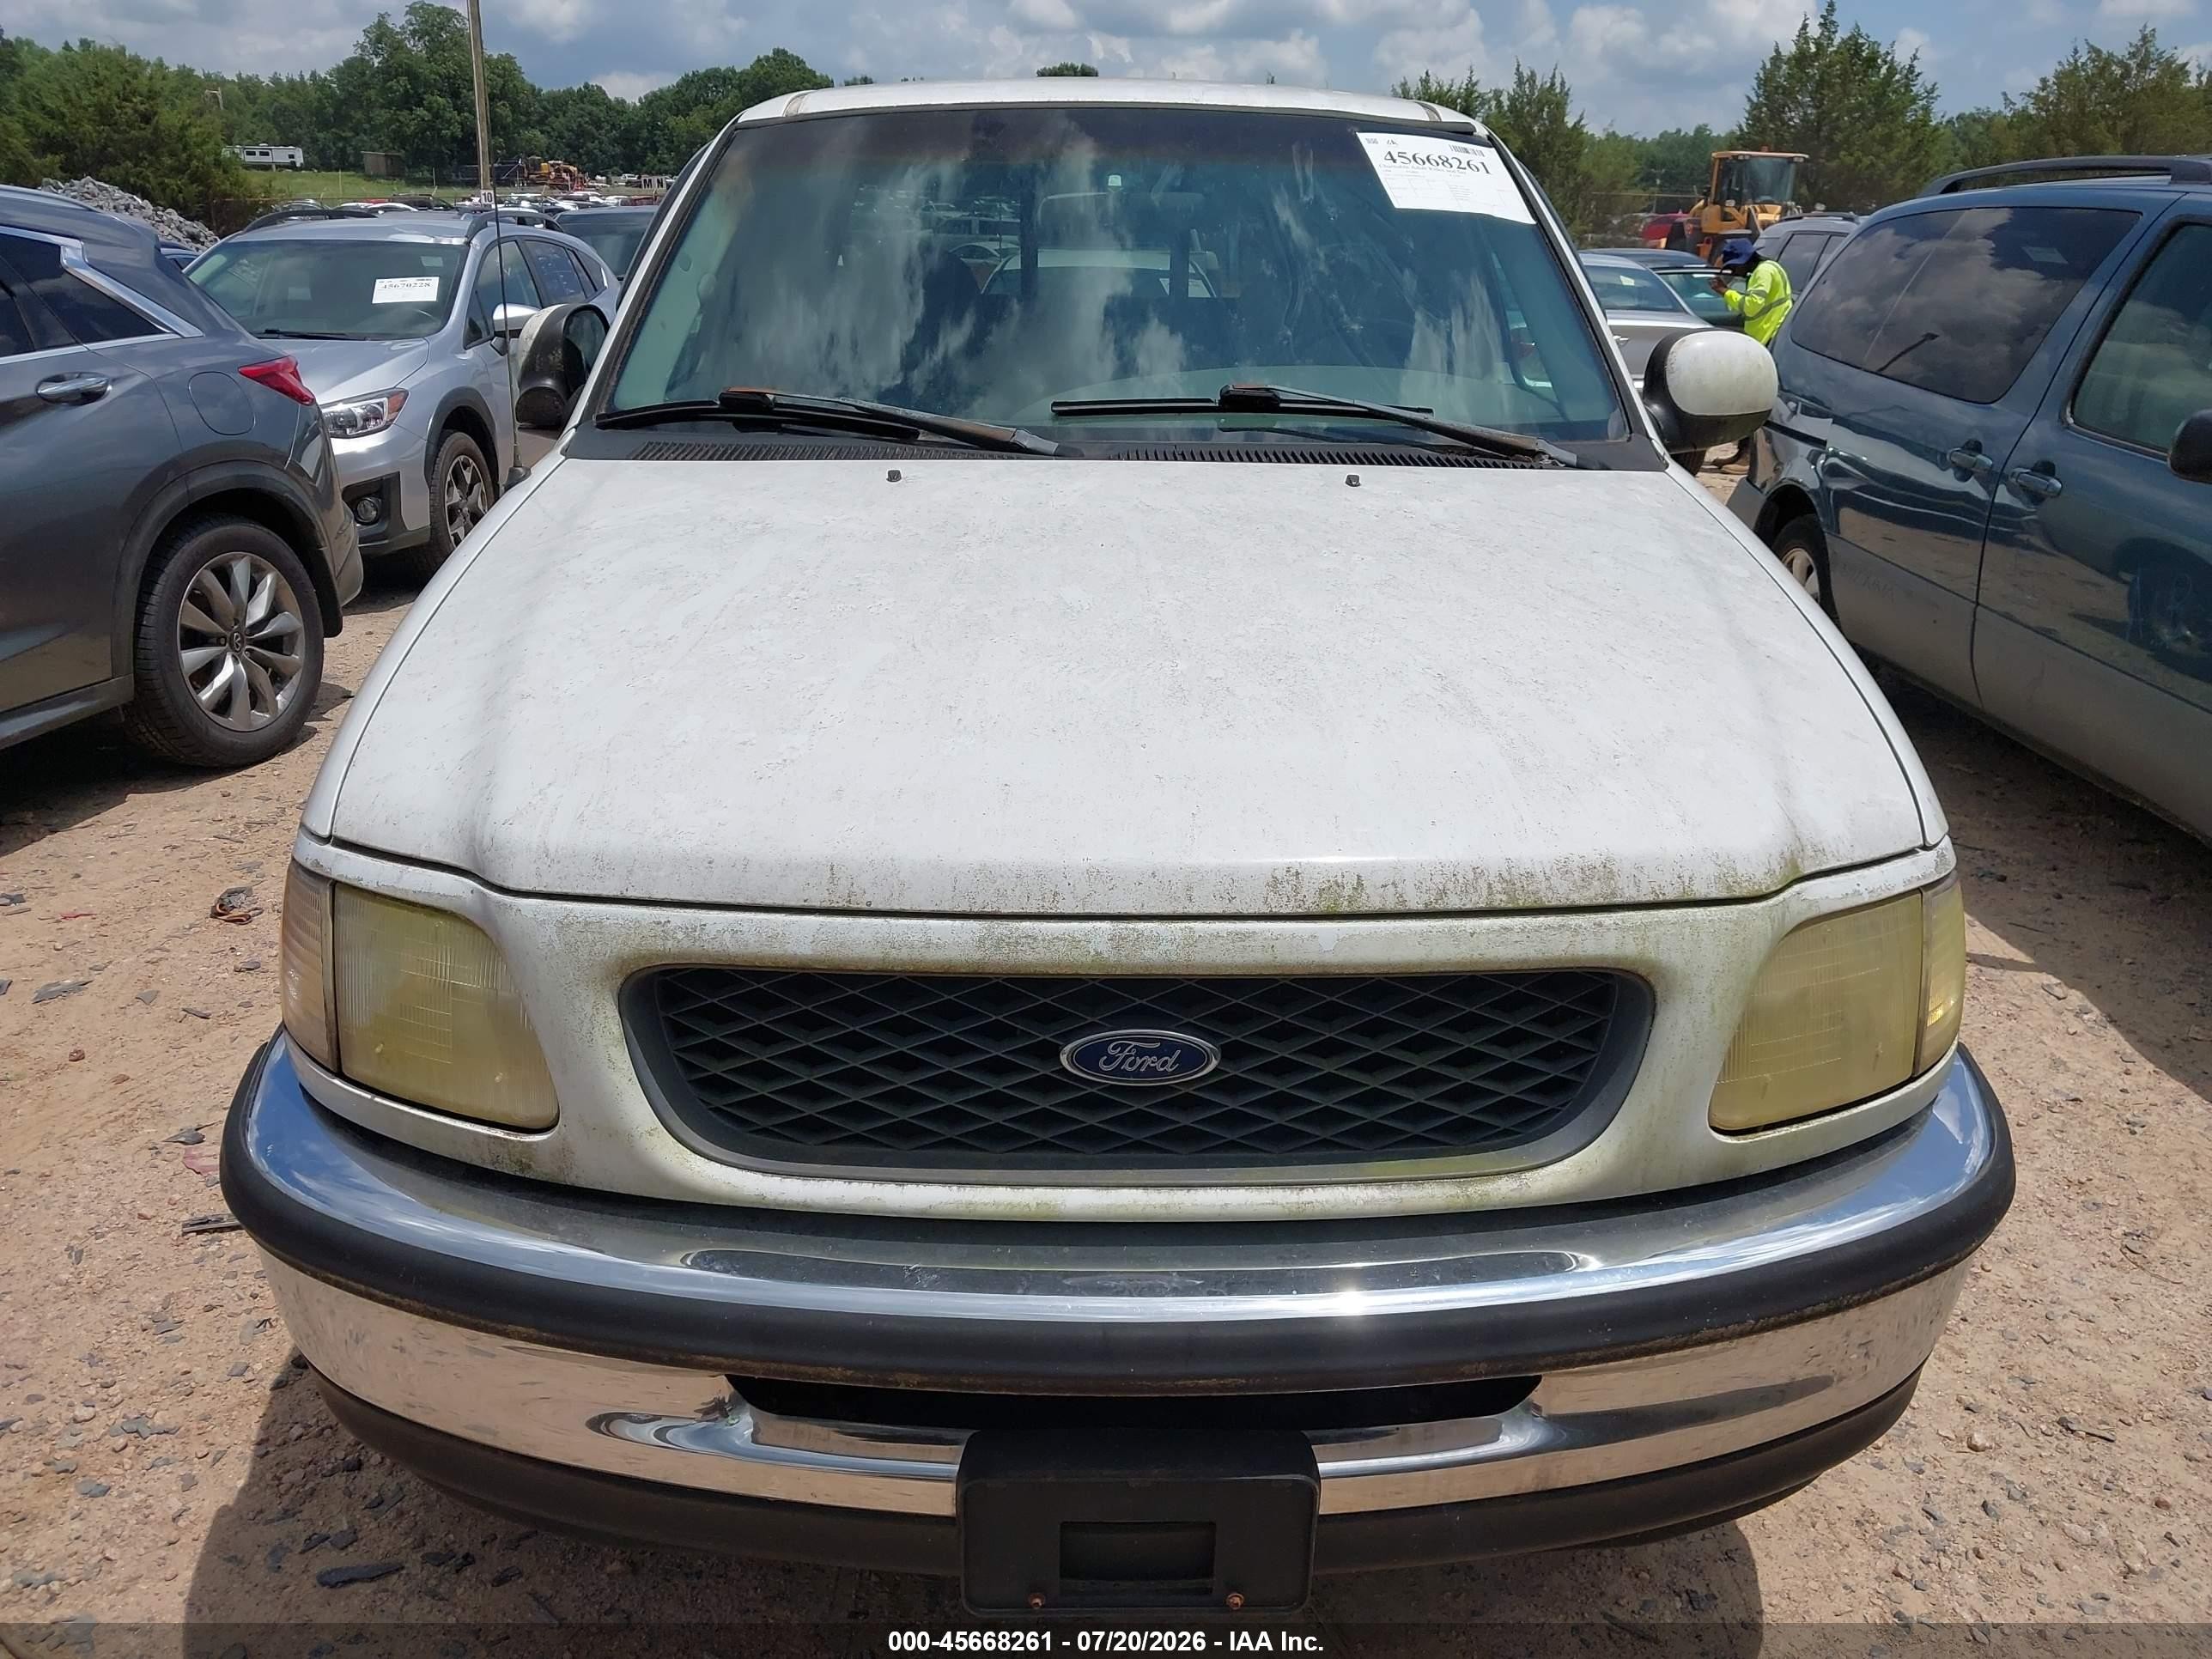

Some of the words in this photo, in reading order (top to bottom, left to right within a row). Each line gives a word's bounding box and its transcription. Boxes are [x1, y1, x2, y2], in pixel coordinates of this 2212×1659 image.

[1383, 150, 1491, 174] 45668261
[643, 178, 653, 189] M
[656, 178, 664, 189] N
[482, 191, 493, 203] 10
[1098, 1040, 1181, 1072] Ford
